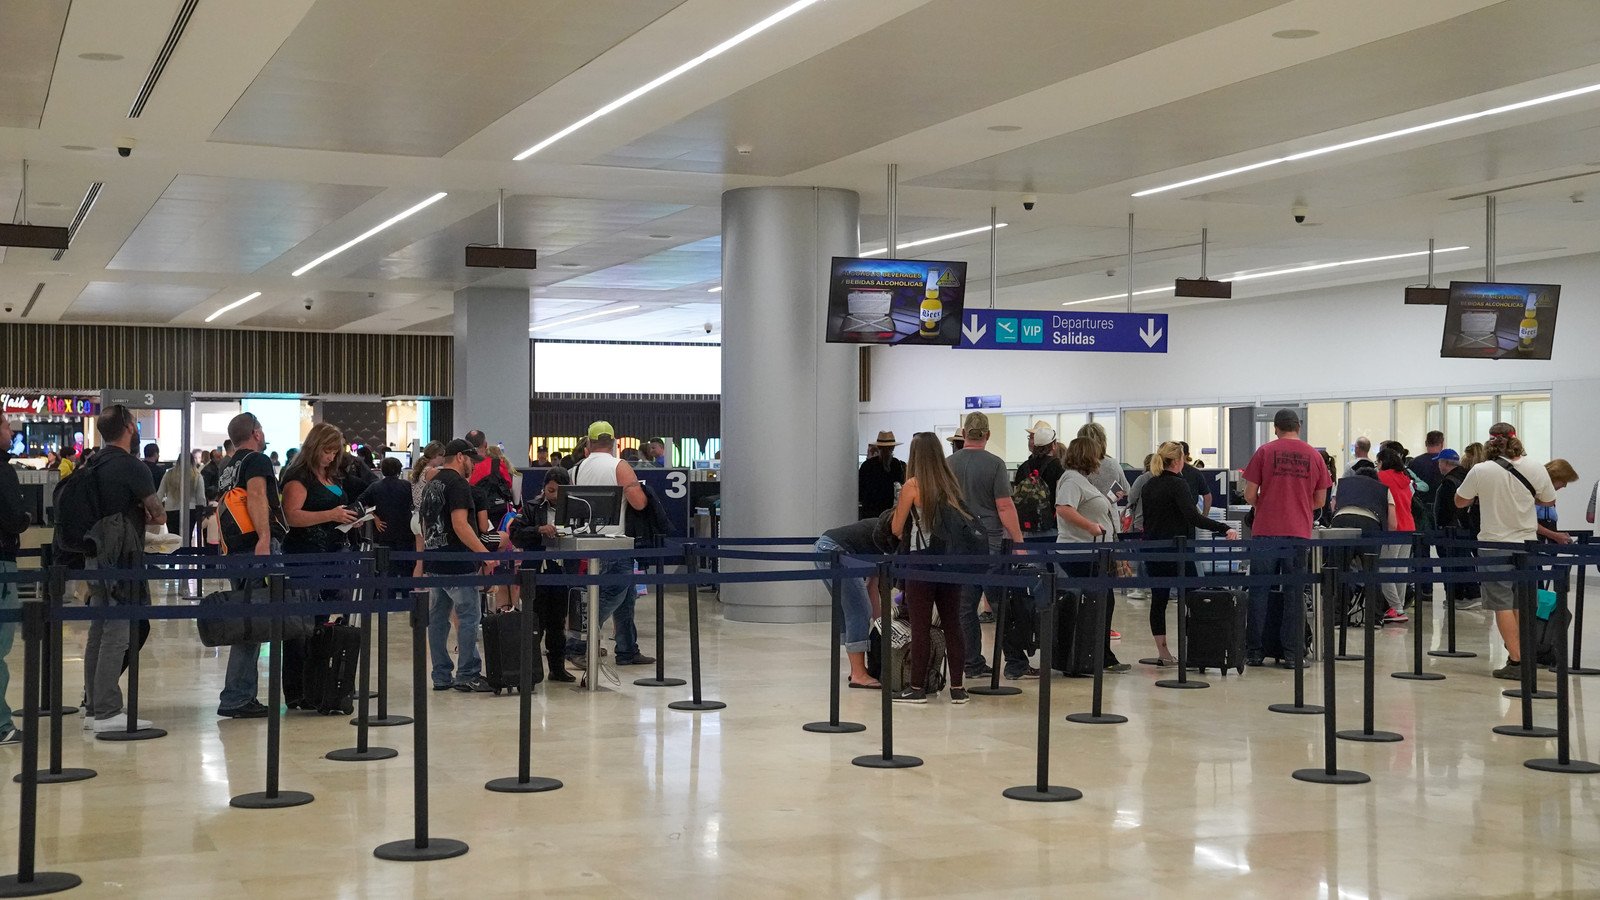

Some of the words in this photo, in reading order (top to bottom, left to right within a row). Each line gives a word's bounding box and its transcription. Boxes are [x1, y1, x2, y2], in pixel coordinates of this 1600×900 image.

[1023, 325, 1041, 336] VIP
[1052, 315, 1114, 331] Departures
[1052, 331, 1095, 345] Salidas
[1, 394, 29, 412] Taste
[32, 395, 45, 413] of
[144, 393, 155, 405] 3
[665, 471, 687, 499] 3
[1215, 471, 1227, 495] 1
